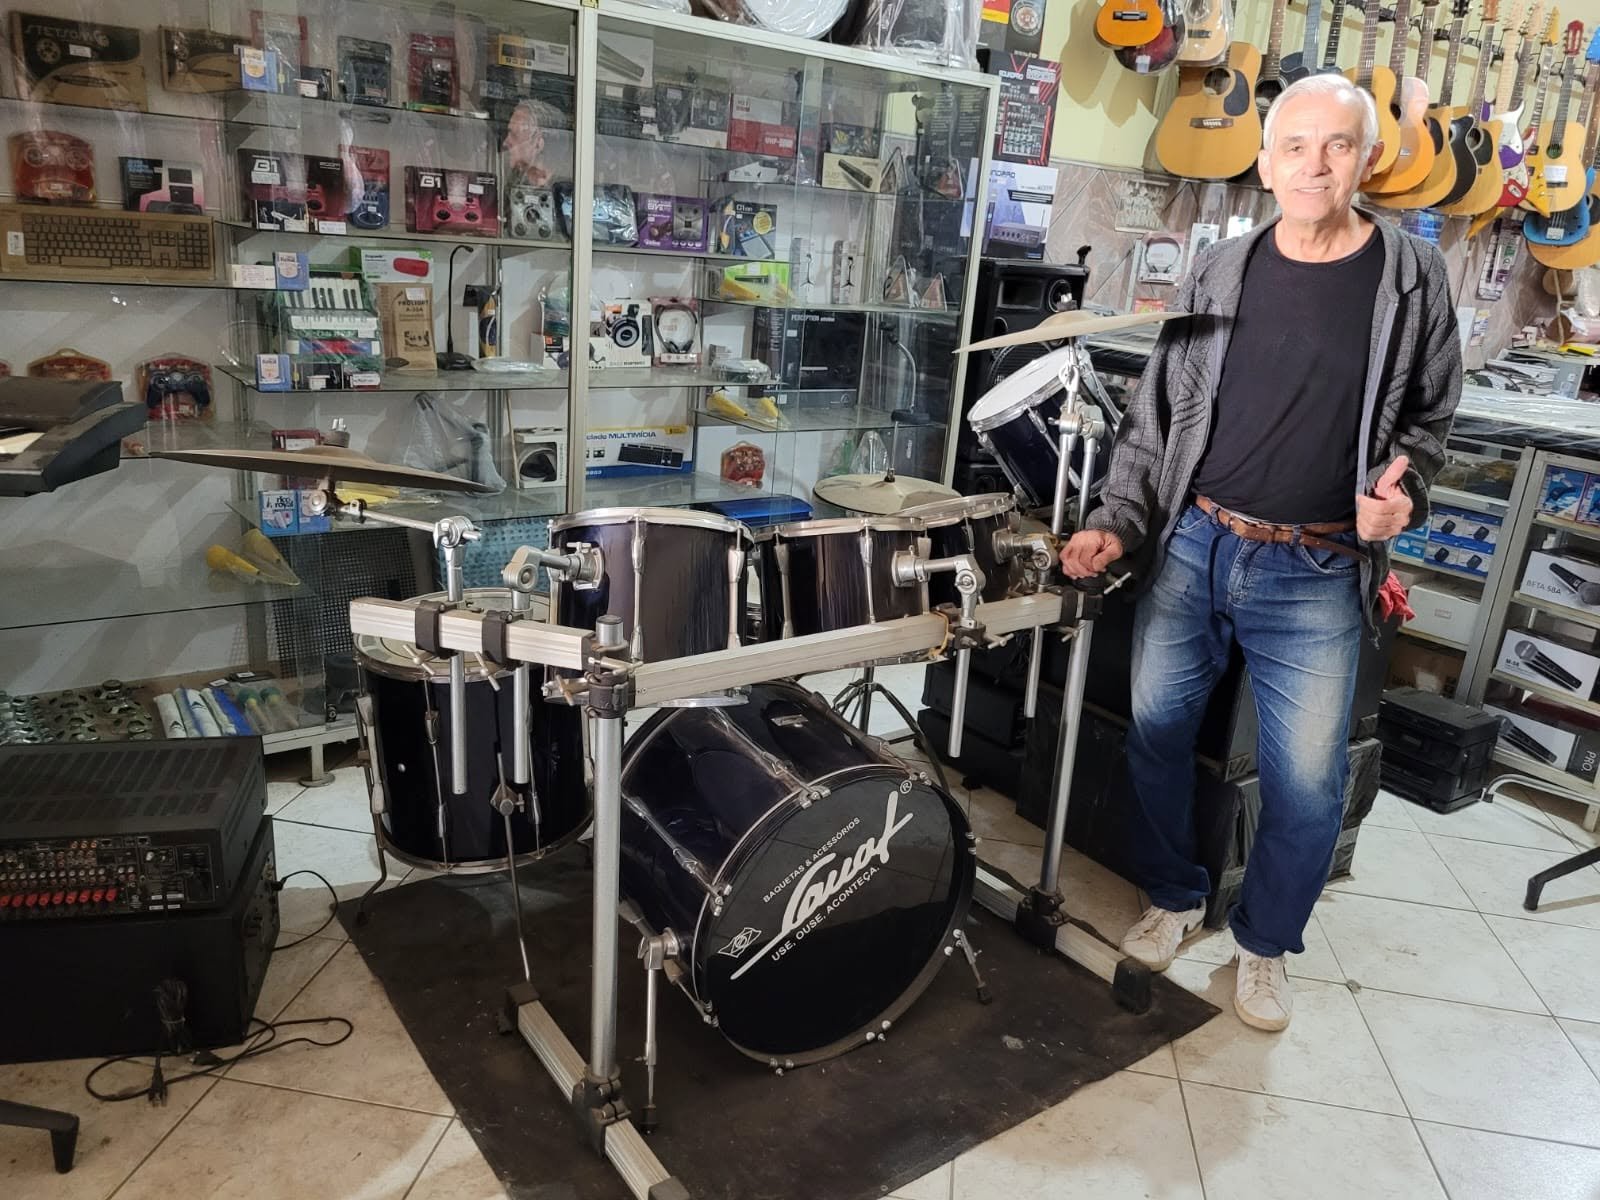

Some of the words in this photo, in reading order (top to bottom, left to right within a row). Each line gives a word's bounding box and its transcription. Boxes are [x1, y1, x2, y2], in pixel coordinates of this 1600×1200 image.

[608, 431, 656, 439] MULTIMÍDIA
[762, 864, 805, 903] BAQUETAS
[812, 817, 860, 861] ACESSÓRIOS
[826, 866, 880, 914] ACONTEÇA.
